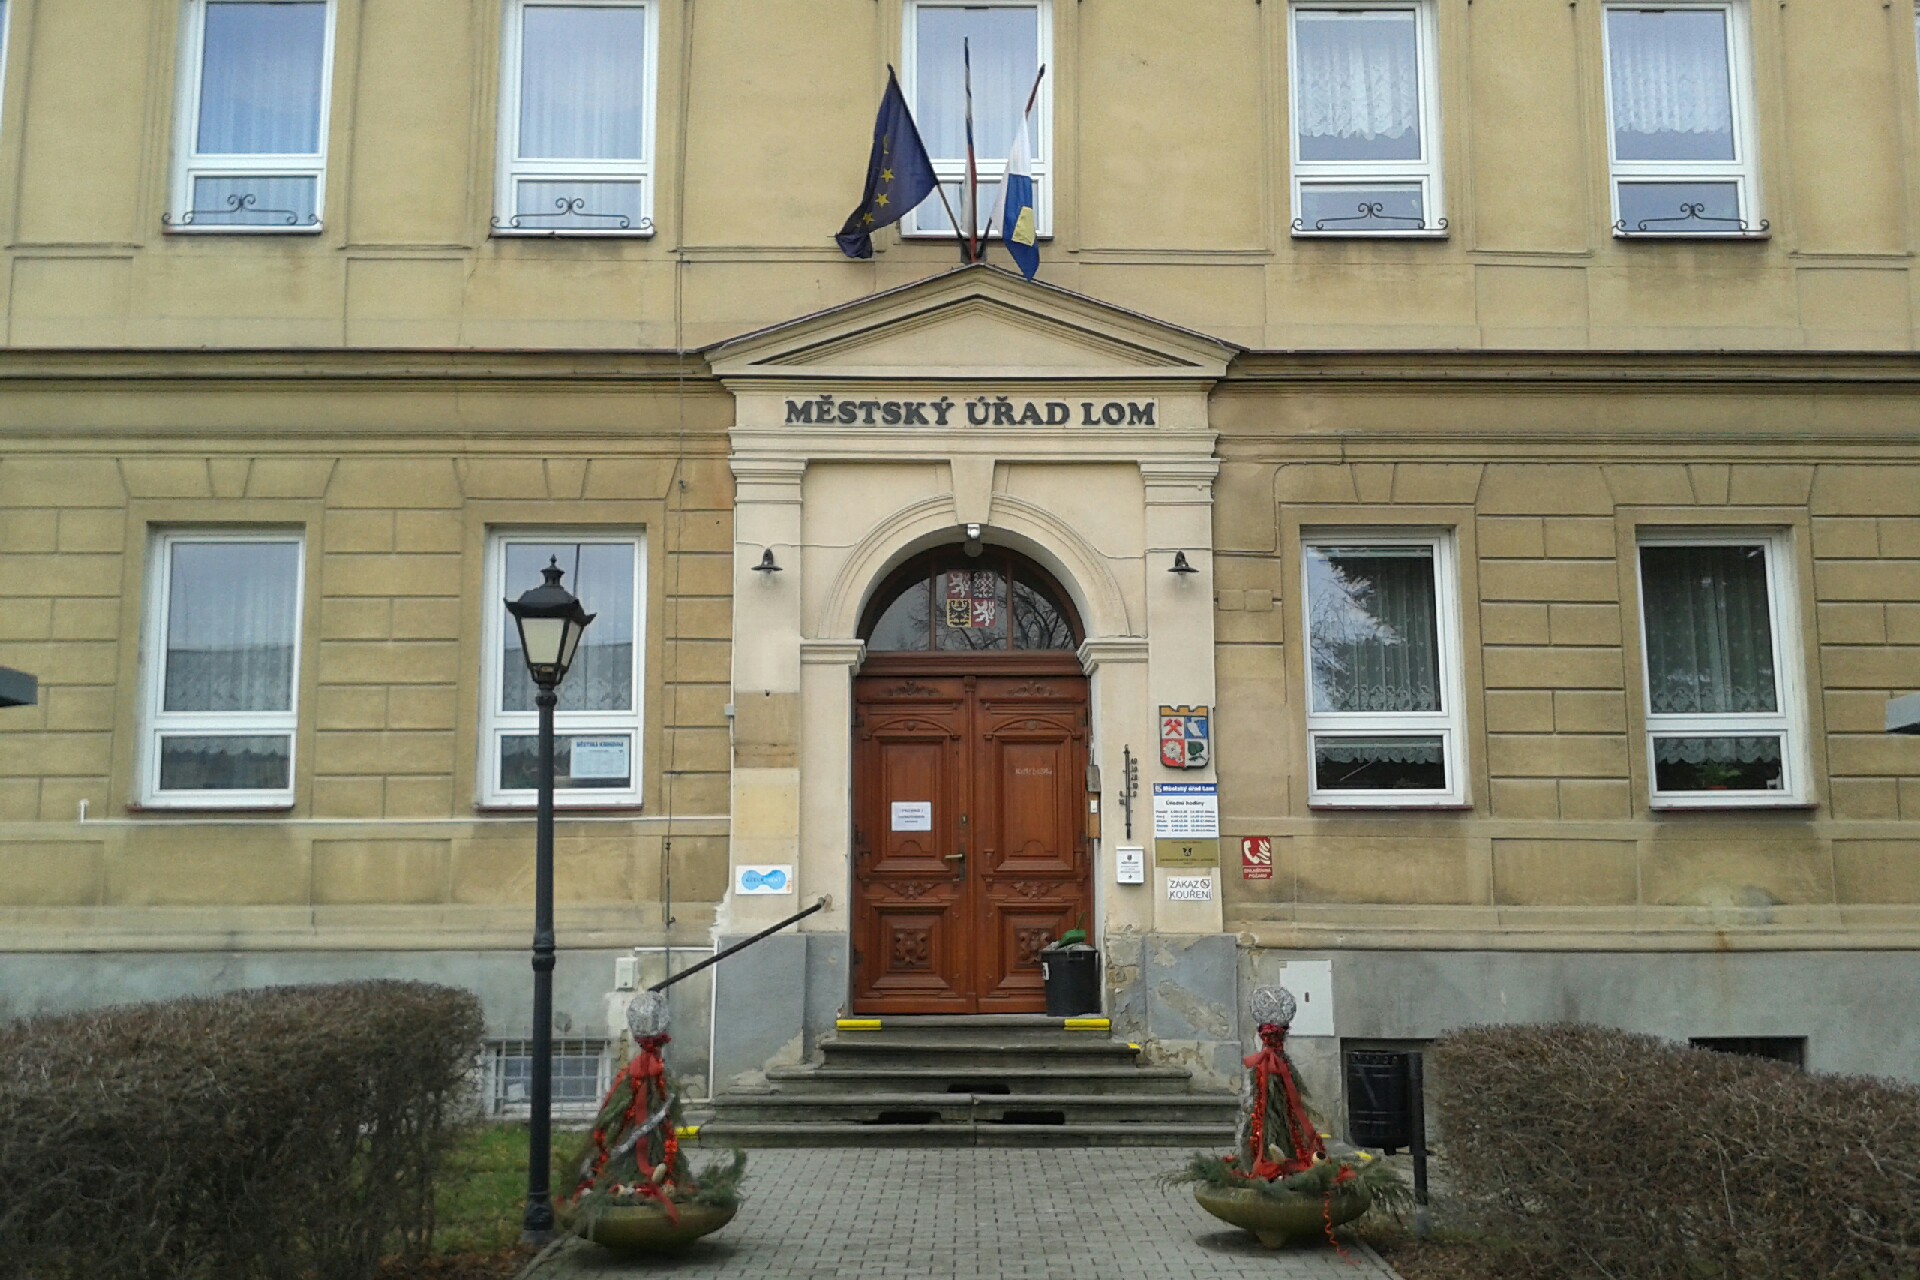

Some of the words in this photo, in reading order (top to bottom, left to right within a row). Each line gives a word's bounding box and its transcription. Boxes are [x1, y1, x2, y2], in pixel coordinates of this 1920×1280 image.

[784, 394, 955, 426] MĚSTSKÝ
[966, 395, 1070, 426] ÚŘAD
[1080, 402, 1156, 426] LOM
[1169, 877, 1200, 889] ZÁKAZ
[1168, 888, 1212, 900] KOUŘENÍ
